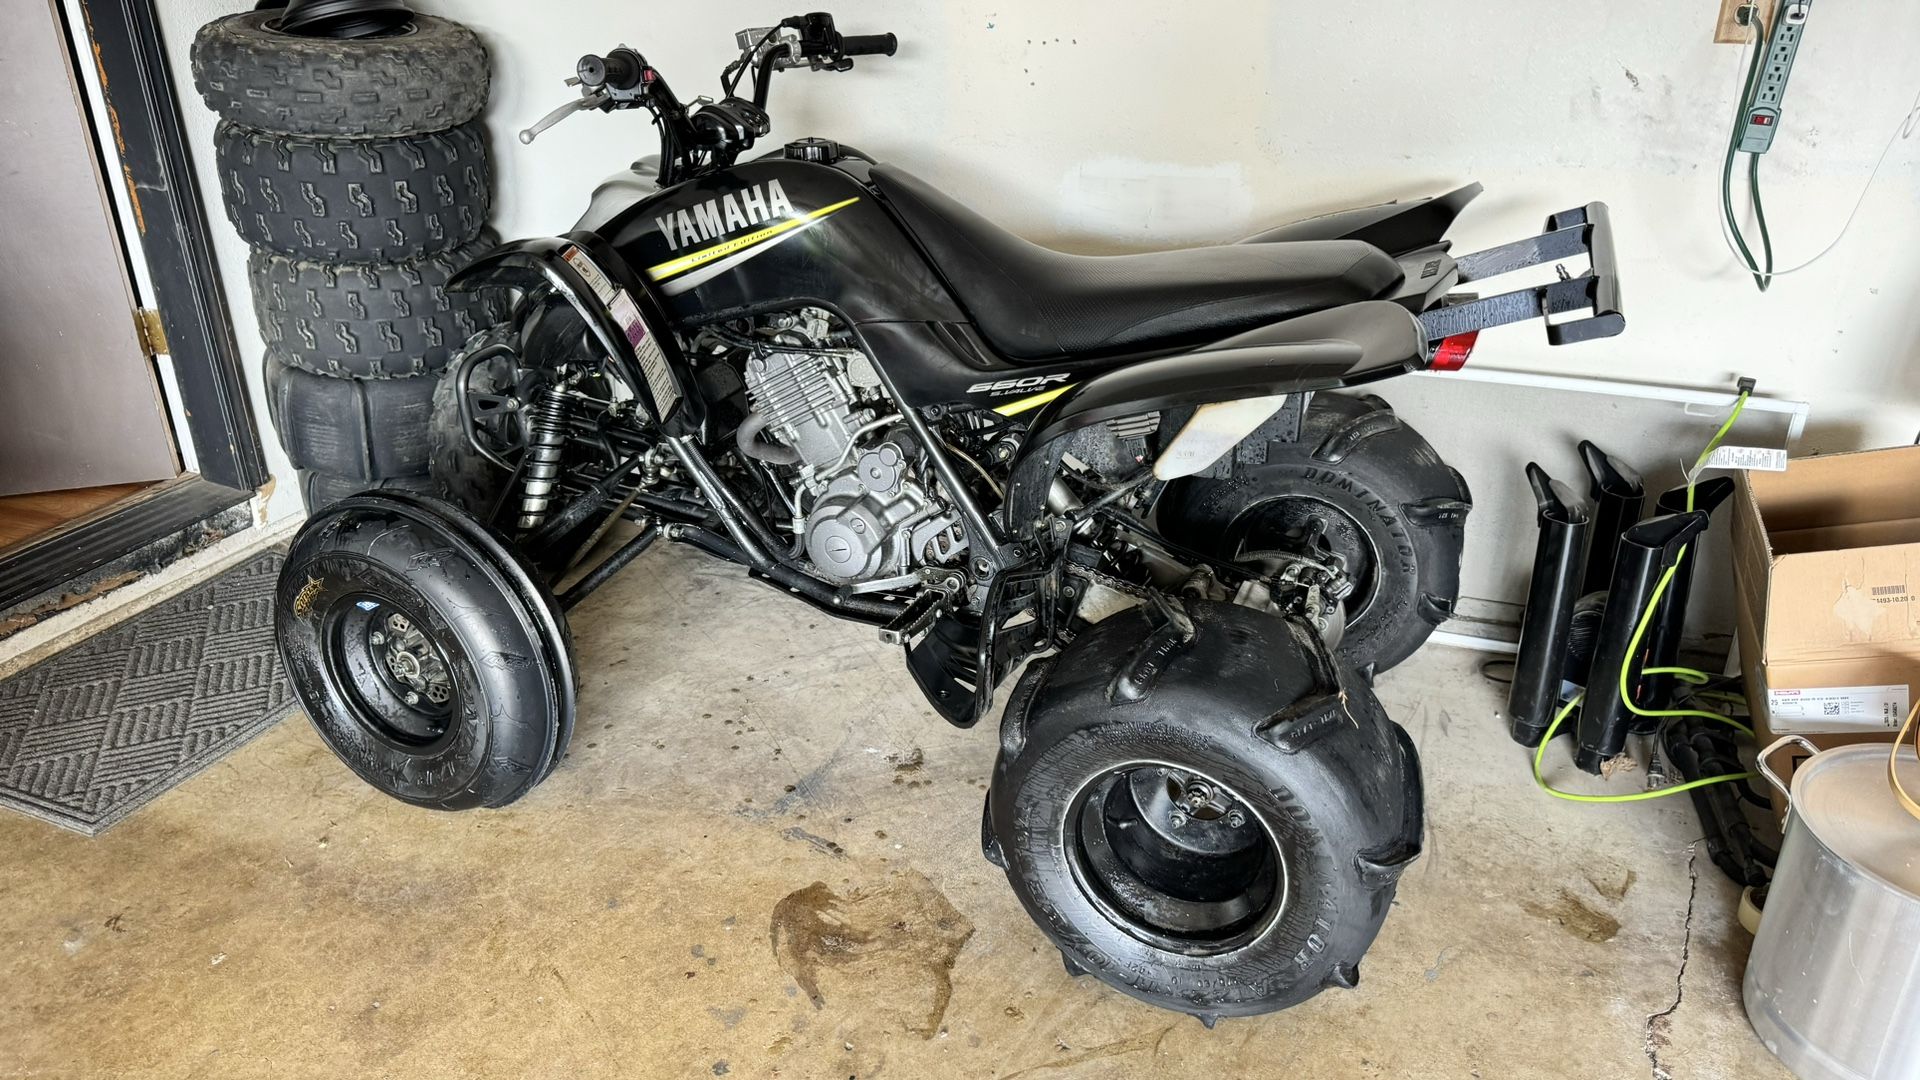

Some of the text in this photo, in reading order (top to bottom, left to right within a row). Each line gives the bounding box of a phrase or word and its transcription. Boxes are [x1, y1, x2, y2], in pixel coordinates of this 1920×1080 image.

[655, 178, 795, 251] YAMAHA
[966, 372, 1072, 393] 660R
[1304, 466, 1416, 576] DOMINATOR
